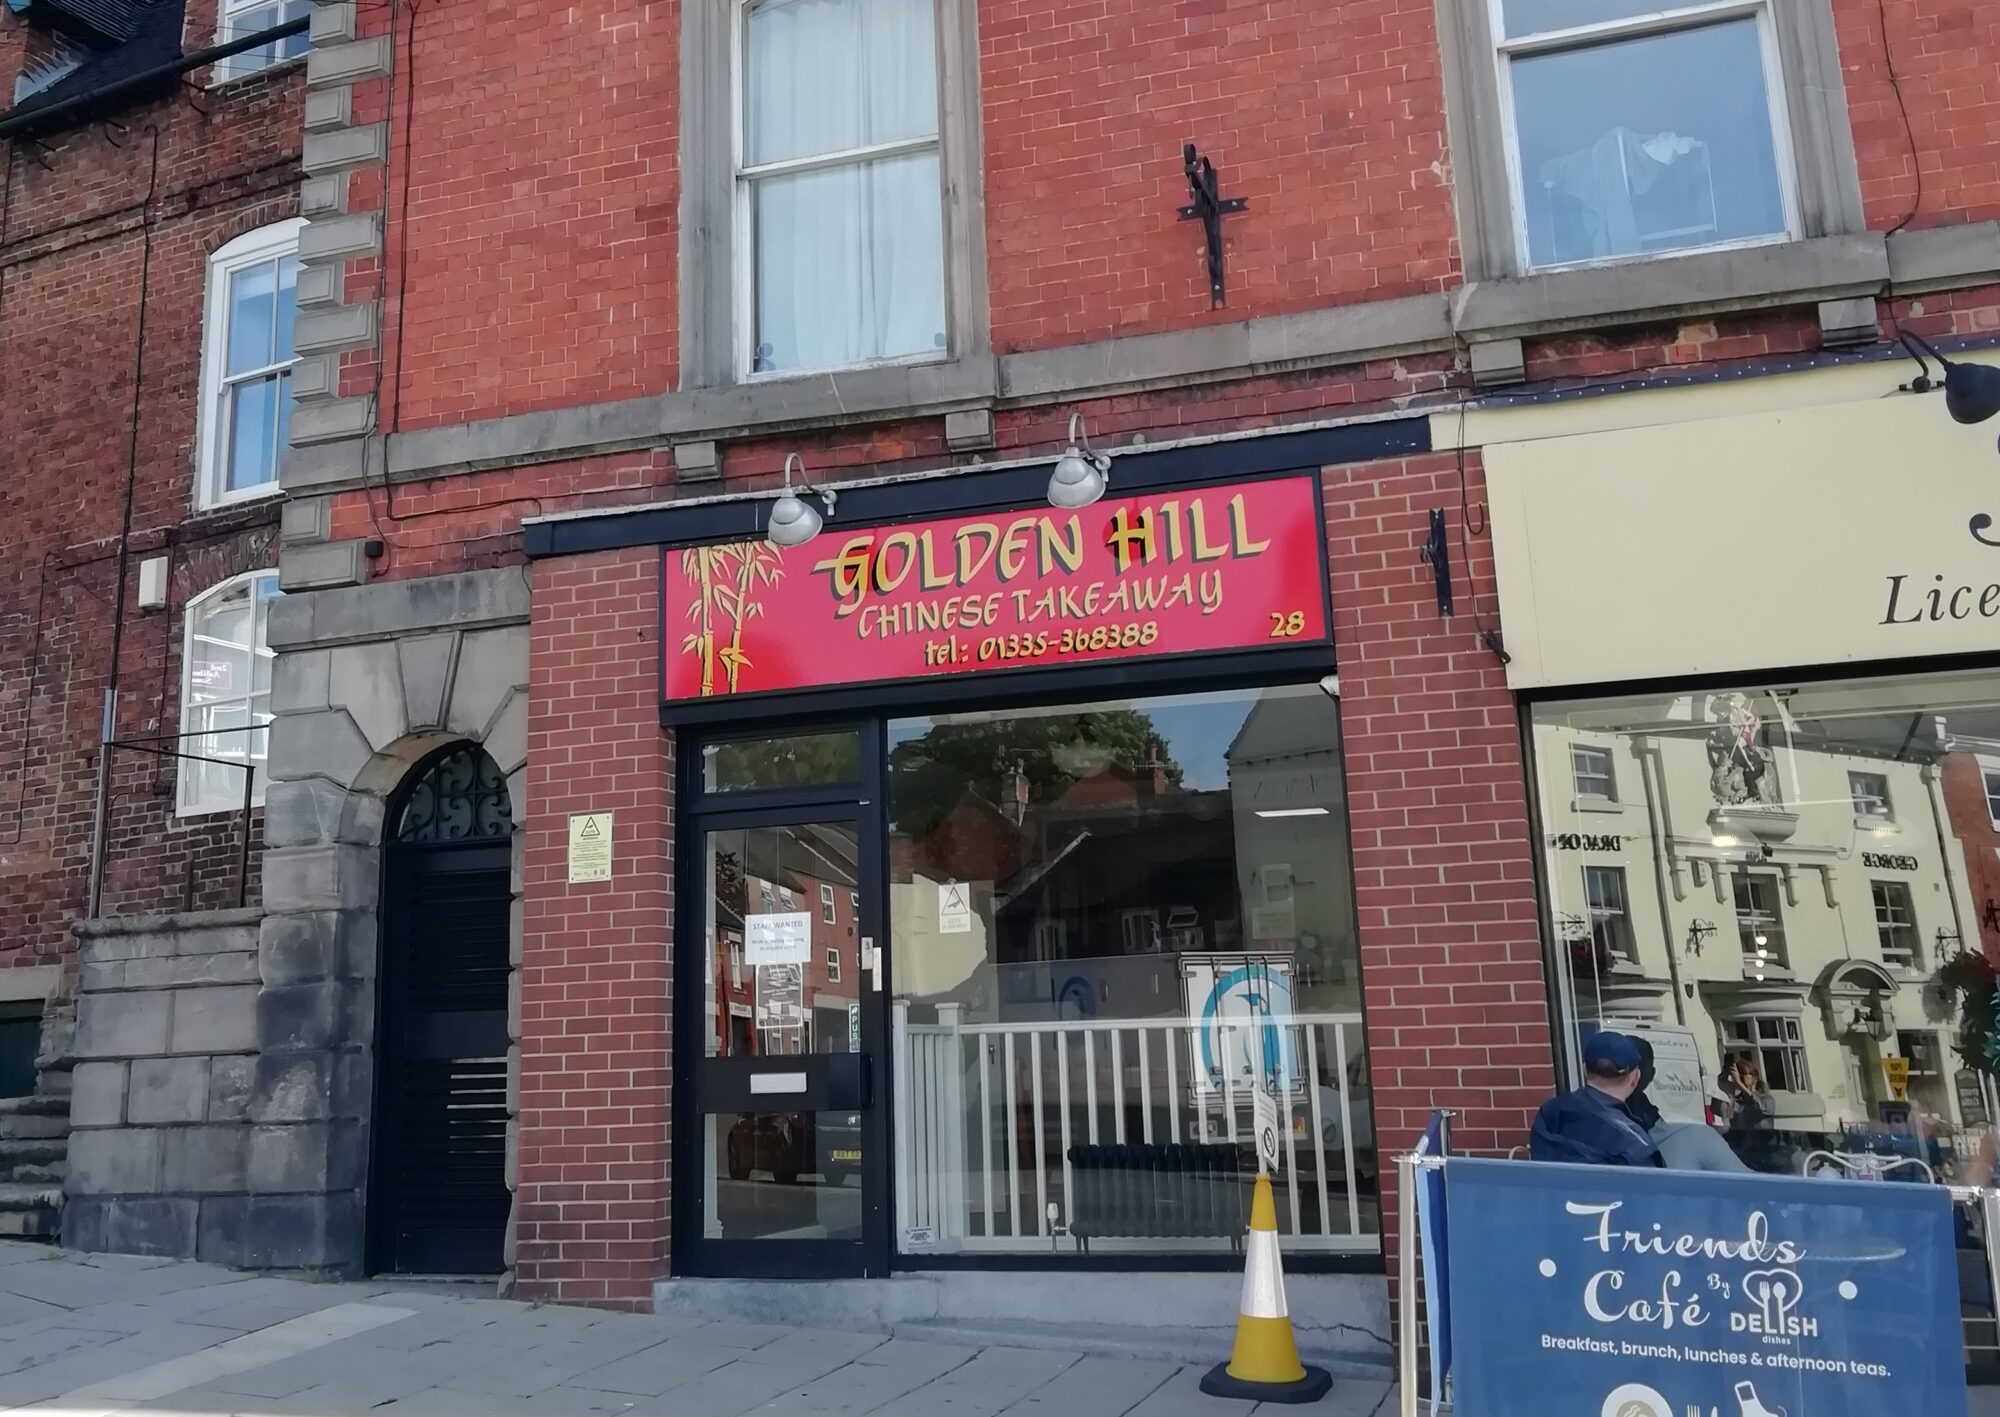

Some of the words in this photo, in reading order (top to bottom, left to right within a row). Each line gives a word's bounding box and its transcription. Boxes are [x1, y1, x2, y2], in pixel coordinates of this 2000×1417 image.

[812, 514, 1085, 612] GOLDEN
[1108, 493, 1271, 574] HILL
[858, 588, 1000, 640] CHINESE
[1011, 569, 1223, 631] TAKEAWAY
[1269, 611, 1305, 637] 28
[1879, 574, 2000, 626] Lice
[925, 640, 969, 667] tel:
[978, 625, 1158, 660] 01335-368388
[1565, 1200, 1806, 1264] Friends
[1583, 1270, 1711, 1330] Café
[1707, 1273, 1731, 1299] By
[1730, 1312, 1818, 1338] DELISH
[1762, 1334, 1792, 1345] dishes
[1541, 1333, 1619, 1357] Breakfast,
[1621, 1341, 1682, 1363] brunch,
[1684, 1347, 1748, 1367] lunches
[1750, 1352, 1764, 1367] &
[1766, 1353, 1847, 1375] afternoon
[1850, 1362, 1892, 1378] teas.
